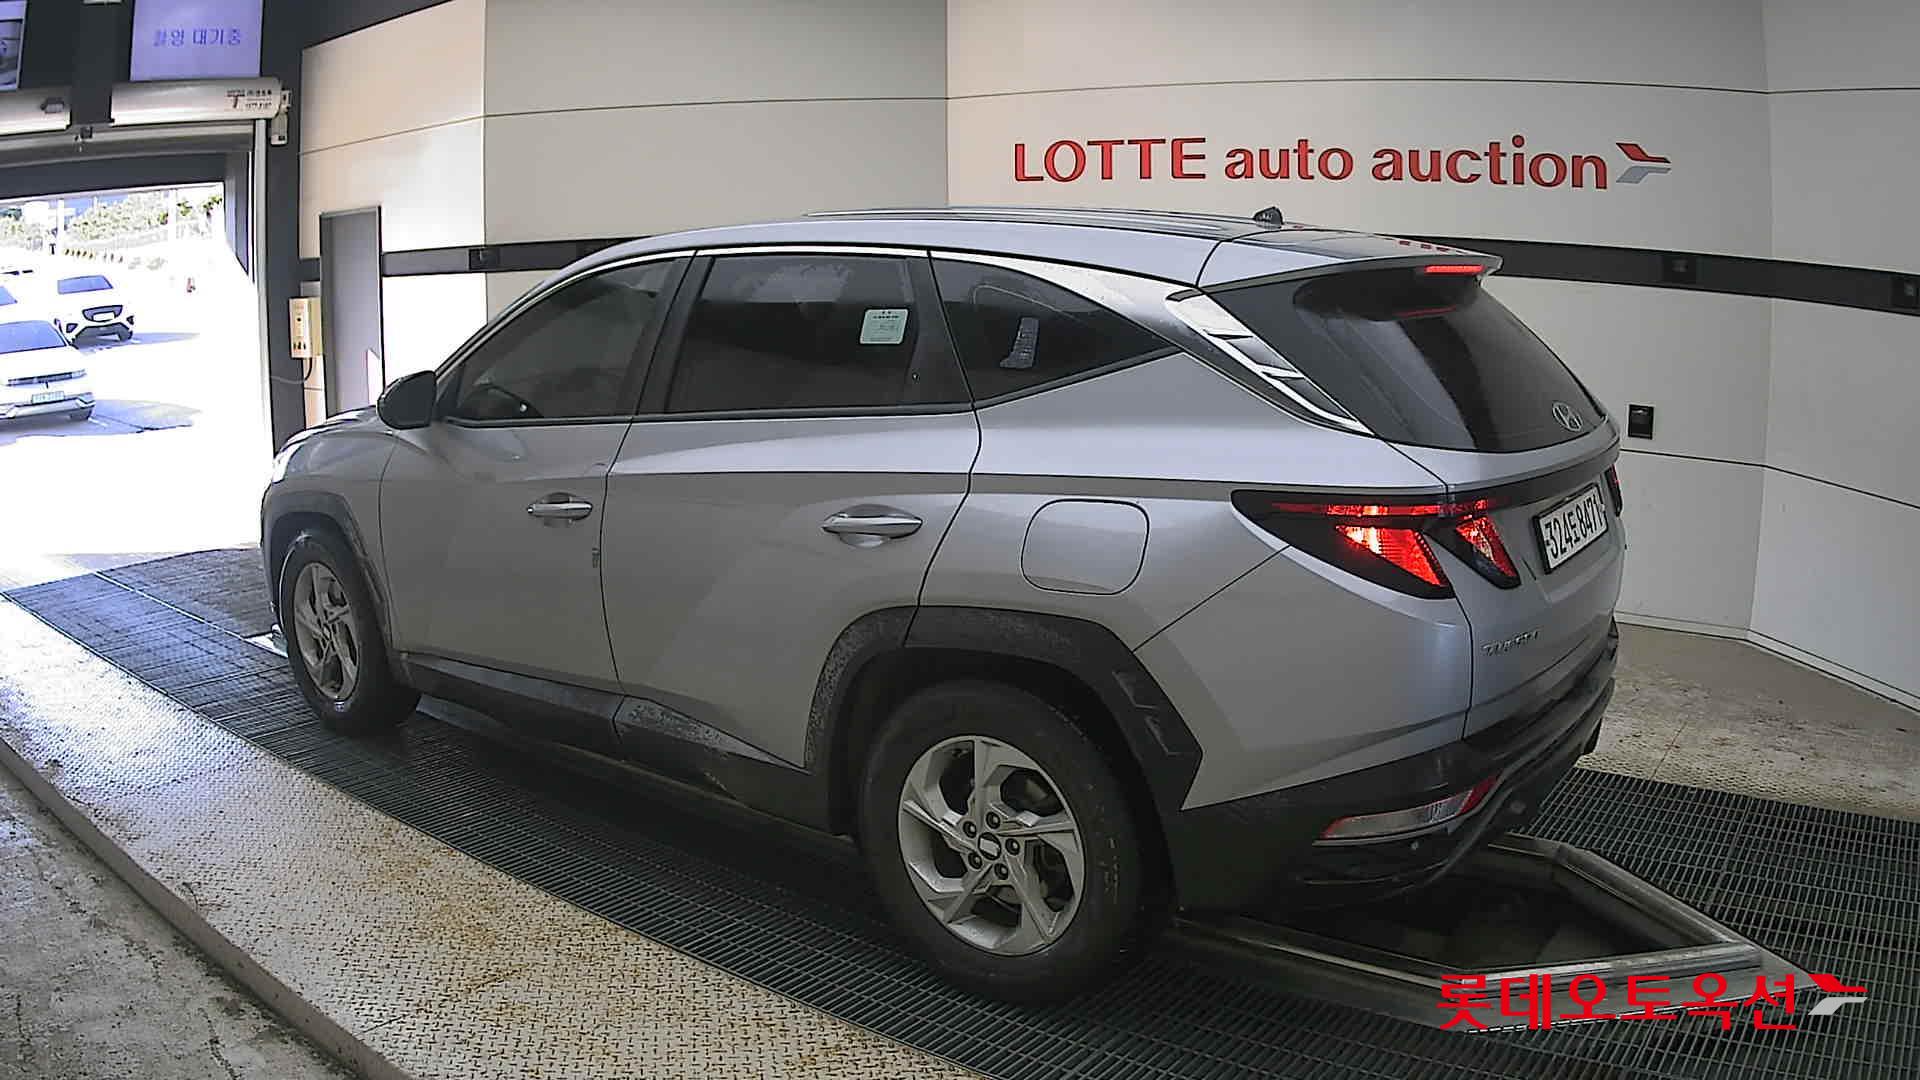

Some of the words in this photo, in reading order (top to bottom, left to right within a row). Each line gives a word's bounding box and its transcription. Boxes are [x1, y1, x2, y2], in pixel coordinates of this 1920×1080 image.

[1014, 137, 1206, 183] LOTTE
[1225, 138, 1354, 181] auto
[1372, 136, 1608, 188] auction
